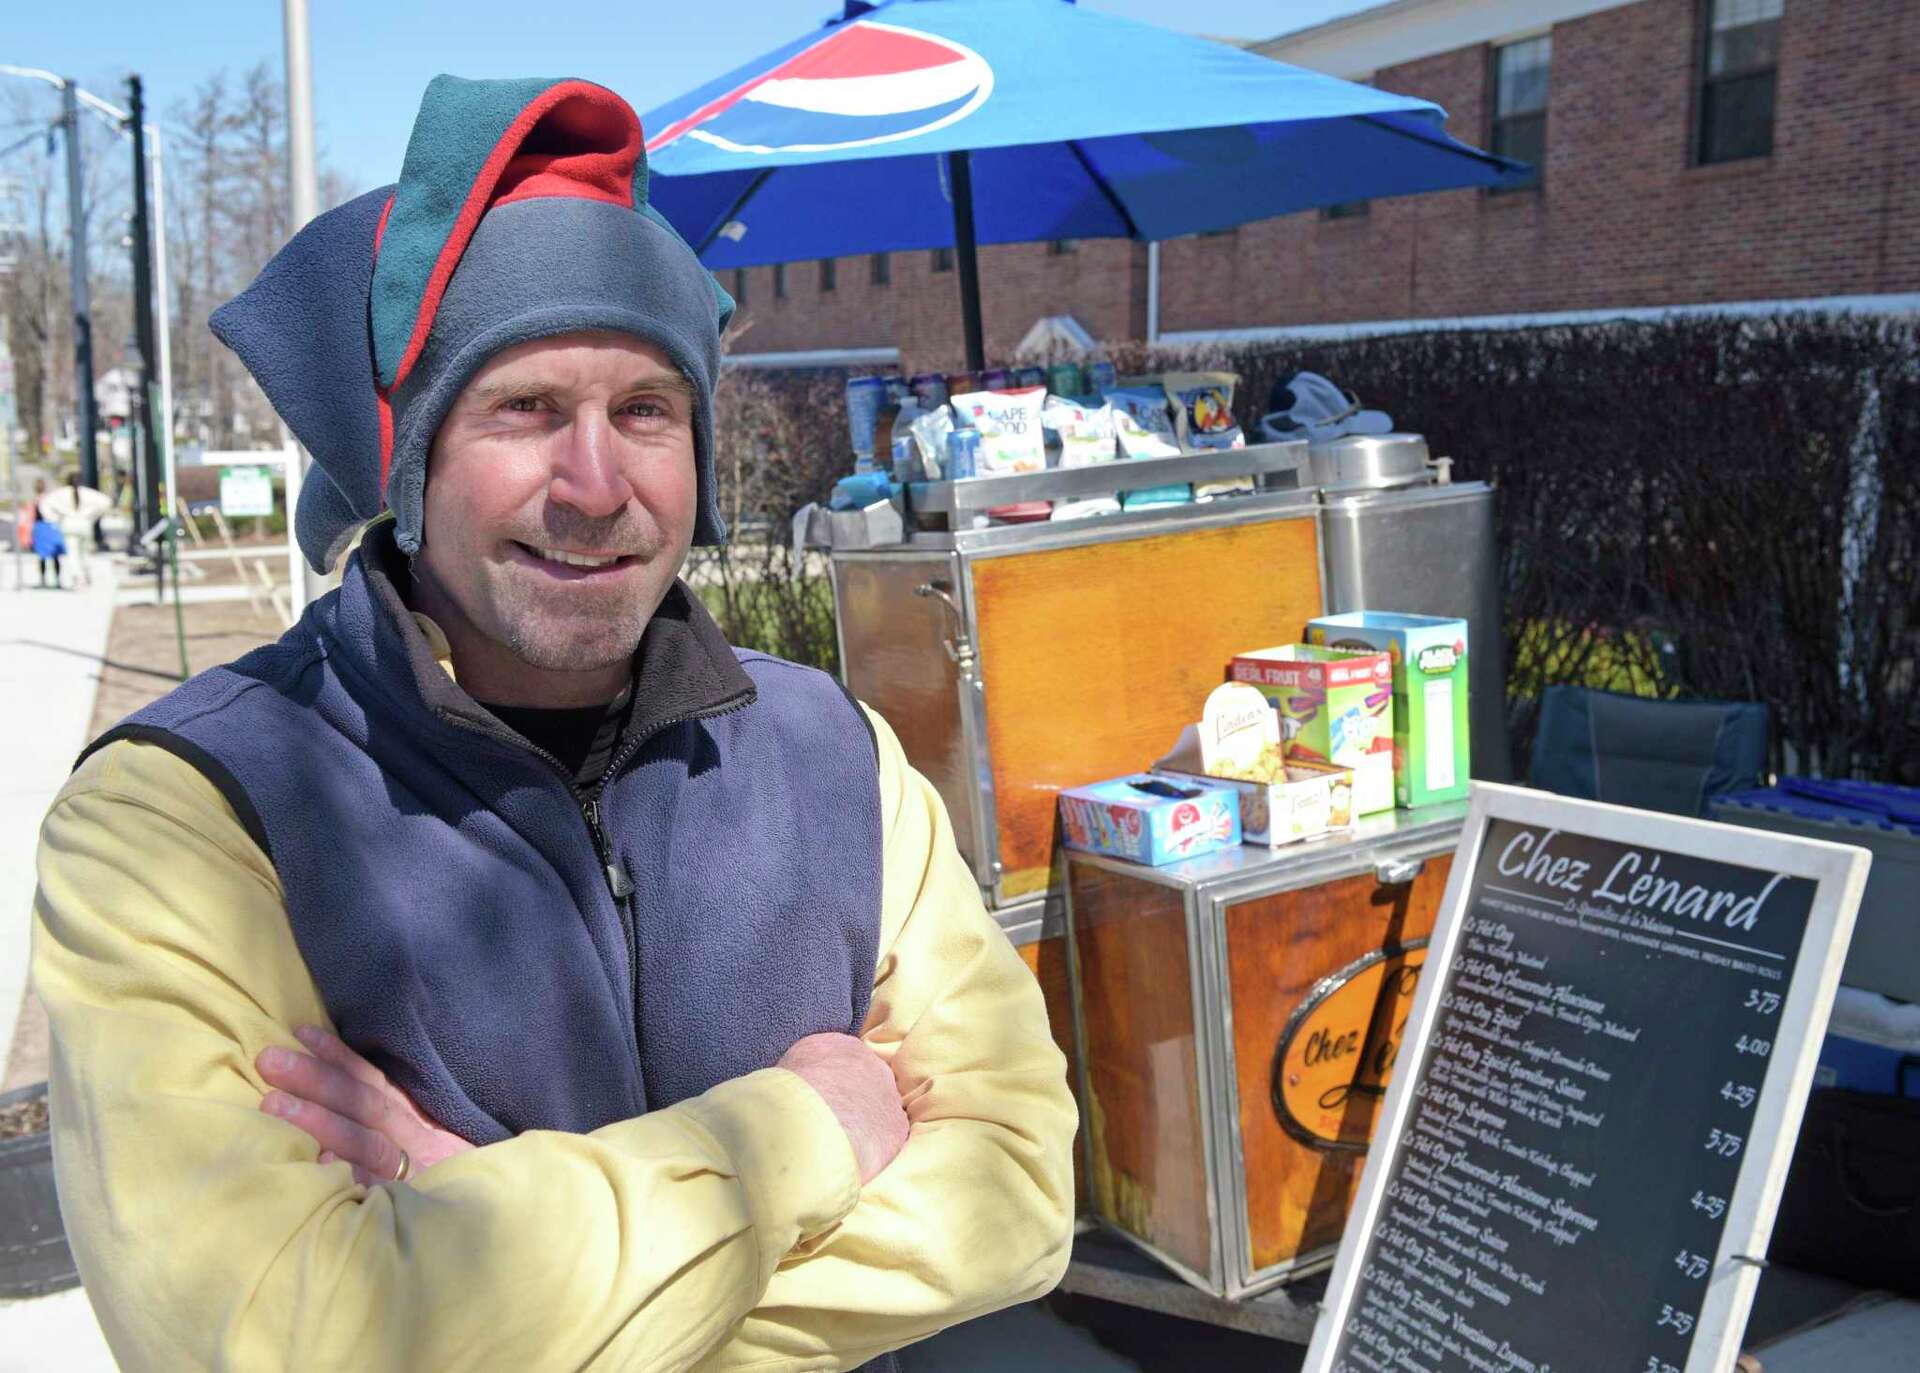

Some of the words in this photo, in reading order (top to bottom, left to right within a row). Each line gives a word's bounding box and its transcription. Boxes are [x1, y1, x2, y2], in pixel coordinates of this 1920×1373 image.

[1496, 827, 1592, 893] Chez
[1592, 850, 1791, 931] Lénard
[1475, 919, 1497, 937] Hot
[1490, 923, 1515, 953] Dog
[1464, 957, 1486, 977] Hot
[1482, 963, 1504, 989] Dog
[1453, 995, 1475, 1015] Hot
[1471, 1001, 1493, 1029] Dog
[1304, 1027, 1359, 1067] Chez
[1441, 1035, 1463, 1055] Hot
[1460, 1041, 1481, 1070] Dog
[1427, 1084, 1449, 1105] Hot
[1445, 1092, 1467, 1121] Dog
[1413, 1134, 1435, 1156] Hot
[1431, 1142, 1452, 1171] Dog
[1398, 1185, 1420, 1207] Hot
[1416, 1194, 1437, 1223] Dog
[1386, 1227, 1408, 1249] Hot
[1404, 1237, 1425, 1267] Dog
[1374, 1269, 1395, 1292] Hot
[1391, 1279, 1412, 1310] Dog
[1357, 1323, 1379, 1347] Hot
[1375, 1334, 1396, 1366] Dog
